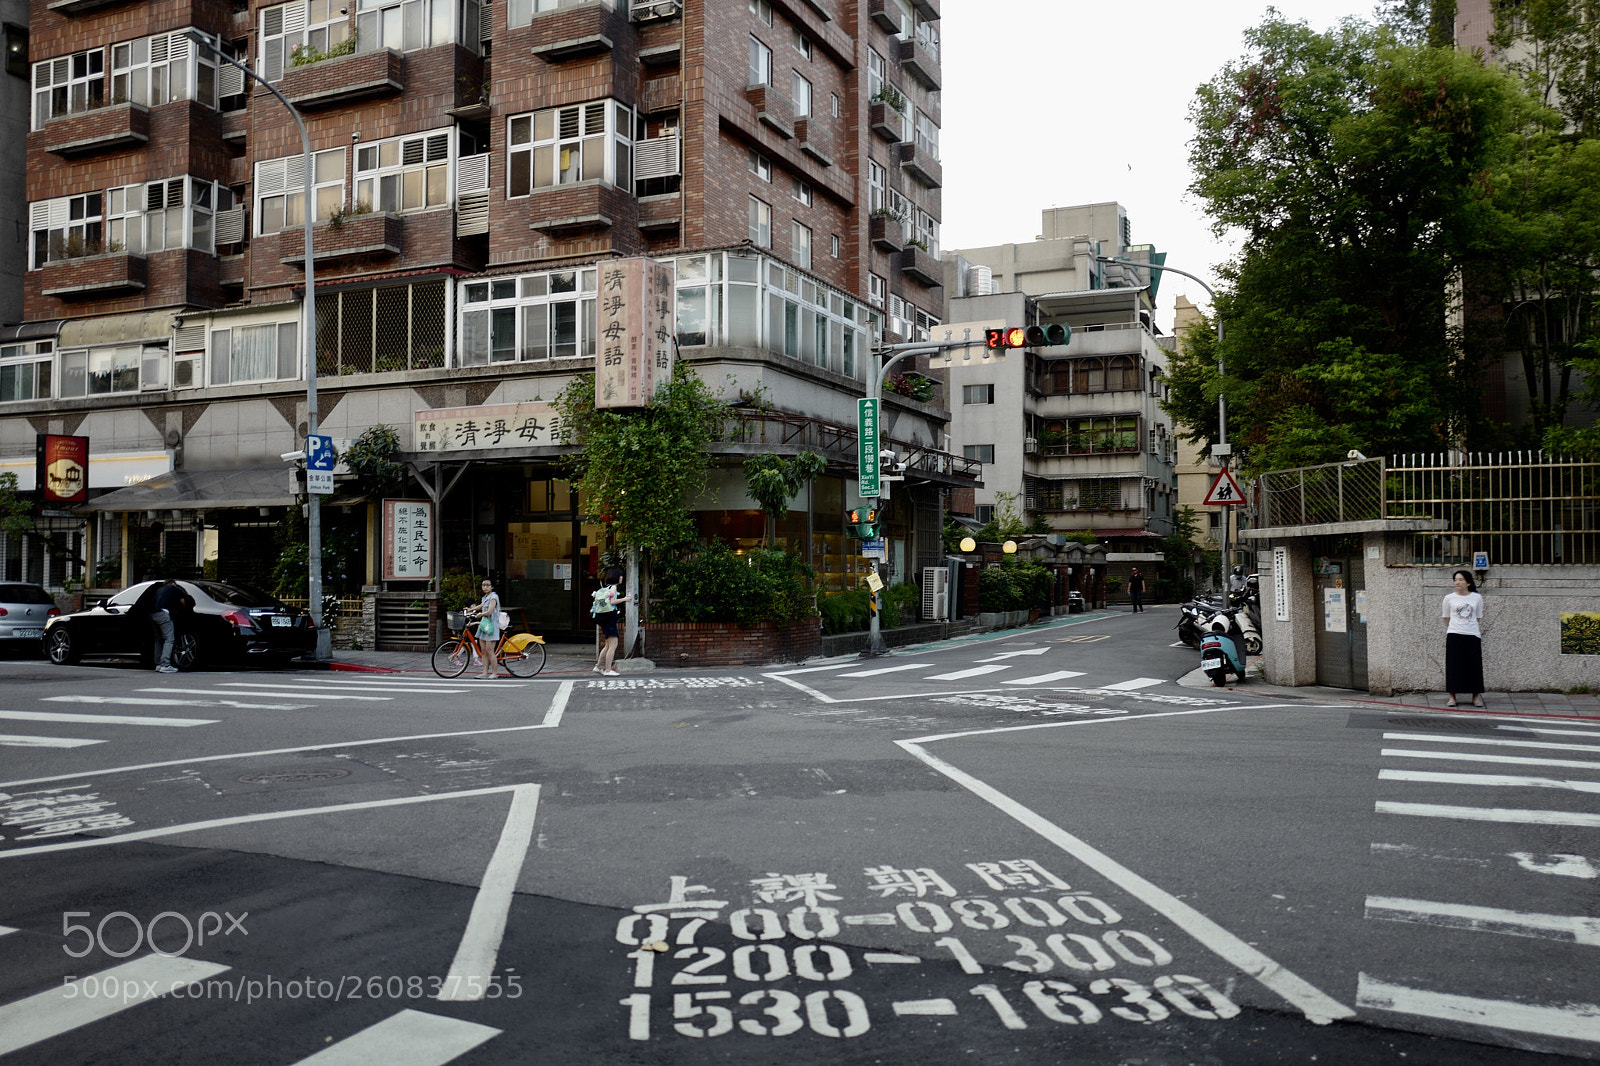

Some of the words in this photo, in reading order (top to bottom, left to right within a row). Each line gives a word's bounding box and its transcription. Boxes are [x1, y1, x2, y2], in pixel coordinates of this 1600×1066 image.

[602, 269, 627, 367] 清淨母語
[308, 436, 321, 456] P
[633, 858, 1073, 913] 上課期間
